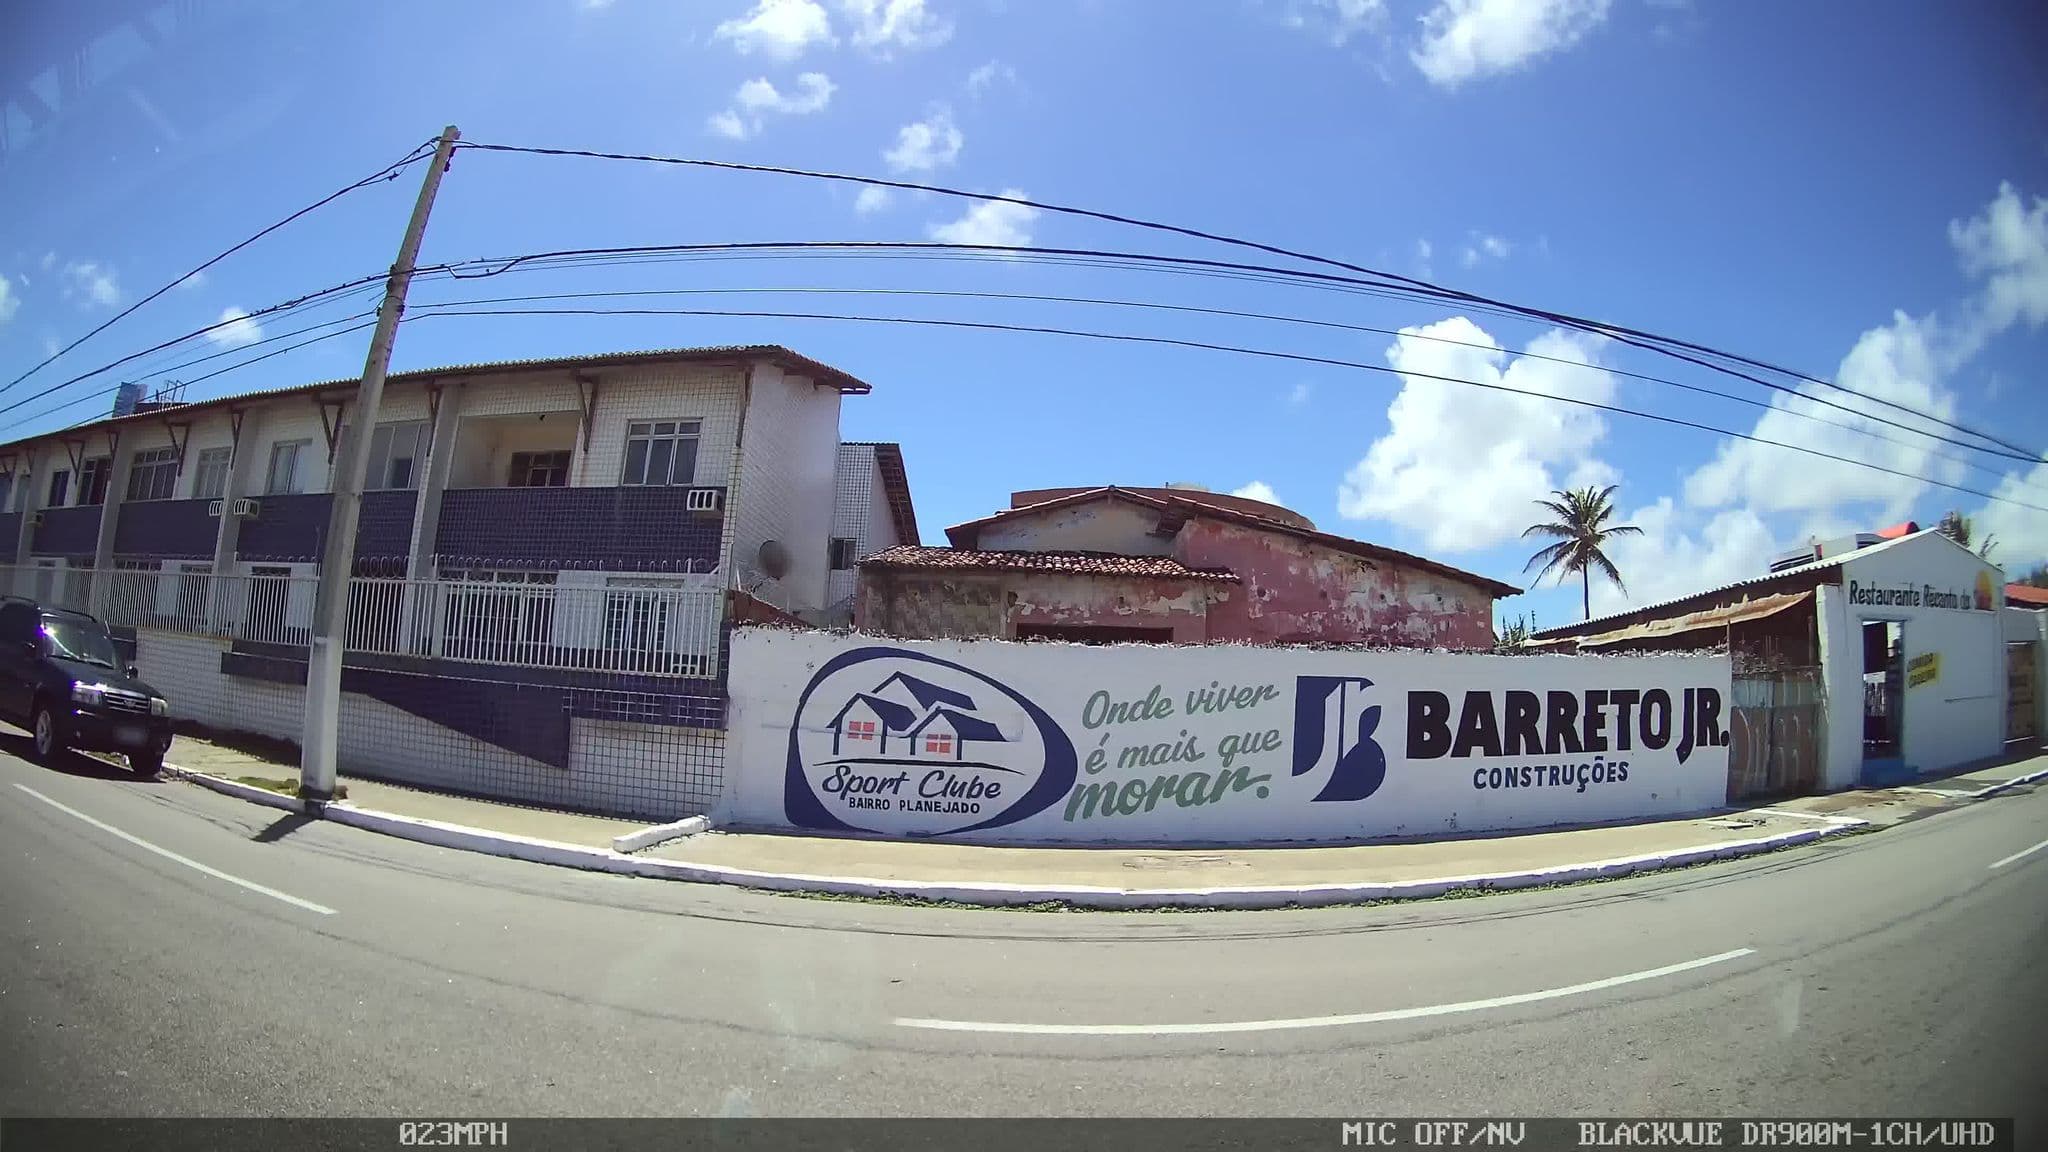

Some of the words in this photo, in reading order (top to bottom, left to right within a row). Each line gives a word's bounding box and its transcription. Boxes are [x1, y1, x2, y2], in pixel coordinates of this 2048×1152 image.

[1849, 580, 1920, 606] Restaurante
[1082, 690, 1174, 730] Onde
[1186, 681, 1279, 715] viver
[1406, 688, 1672, 759] BARRETO
[1676, 687, 1730, 765] JR.
[1086, 732, 1107, 775] é
[1118, 729, 1205, 769] mais
[1219, 725, 1283, 768] que
[822, 764, 909, 801] Sport
[918, 769, 1001, 800] Clube
[1063, 765, 1271, 823] morar.
[1473, 756, 1629, 793] CONSTRUÇÕES
[848, 797, 891, 810] BAIRRO
[899, 800, 980, 815] PLANEJADO
